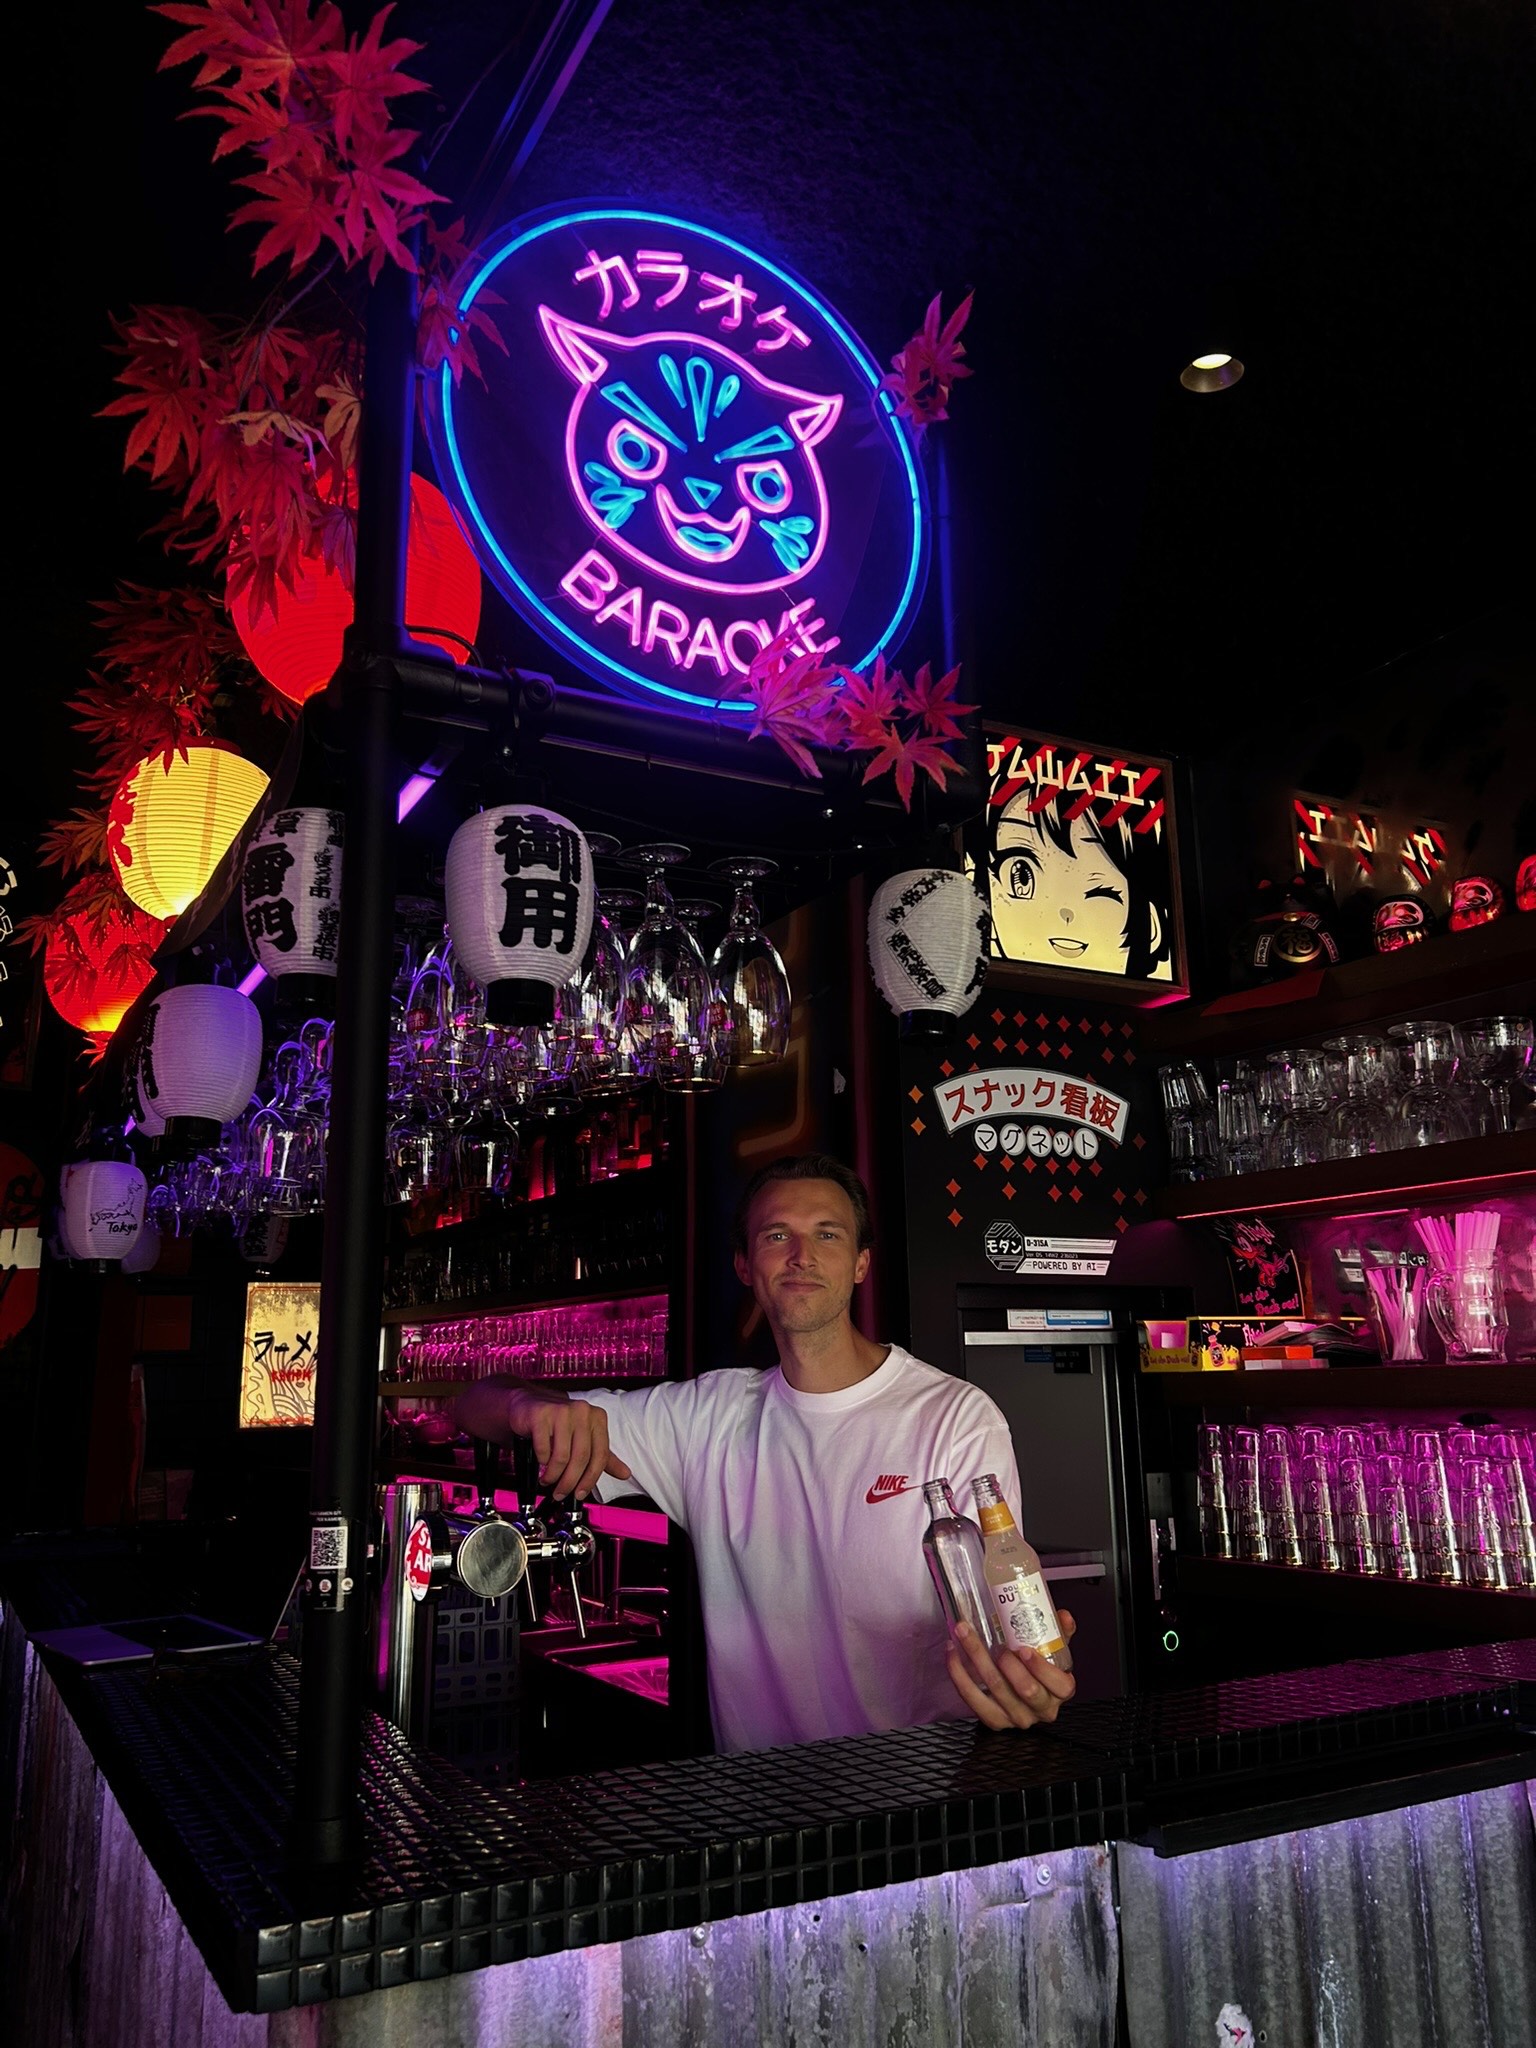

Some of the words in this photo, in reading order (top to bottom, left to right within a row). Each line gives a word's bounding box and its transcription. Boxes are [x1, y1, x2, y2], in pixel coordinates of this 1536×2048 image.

[574, 250, 812, 350] カラオケ
[495, 814, 582, 954] 御用
[944, 1077, 1121, 1133] スナック看板
[977, 1128, 1095, 1156] マグネット
[106, 1221, 138, 1235] Tokyo
[1032, 1260, 1068, 1270] POWERED
[1072, 1261, 1082, 1270] BY
[1086, 1262, 1097, 1271] AI
[254, 1330, 319, 1362] ラーメ
[874, 1475, 909, 1490] NIKE
[998, 1584, 1040, 1604] DUTCH
